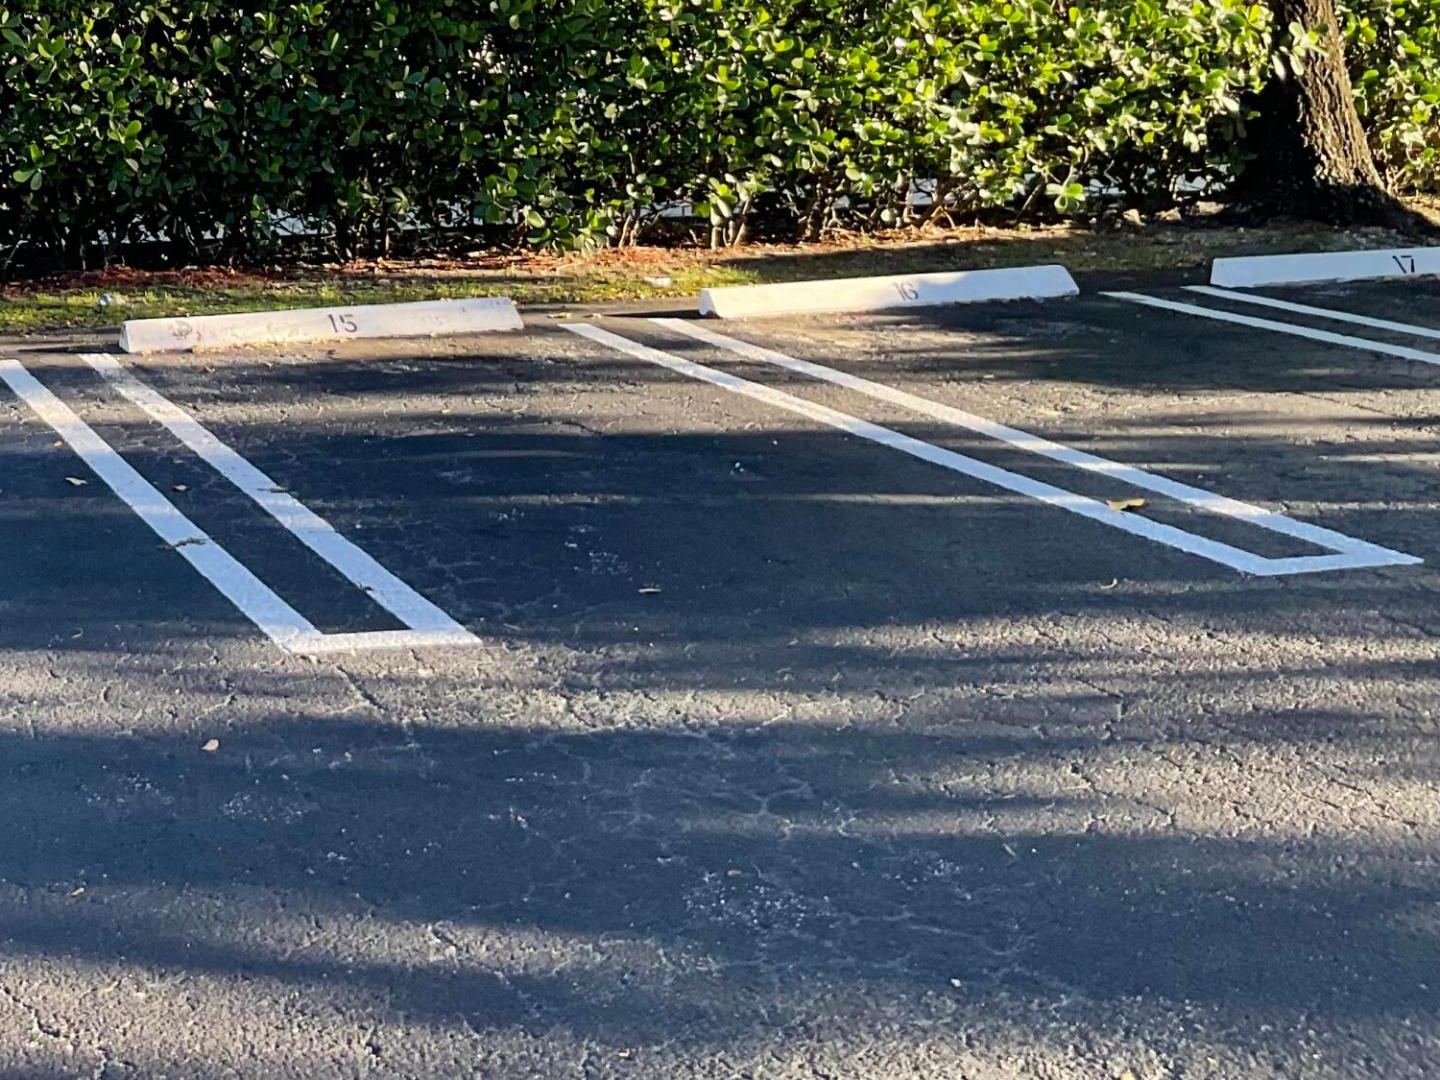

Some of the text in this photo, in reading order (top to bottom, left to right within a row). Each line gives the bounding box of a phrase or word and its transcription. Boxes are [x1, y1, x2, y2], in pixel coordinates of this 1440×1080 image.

[1392, 255, 1415, 274] 17
[893, 282, 919, 300] 16
[327, 313, 358, 333] 15
